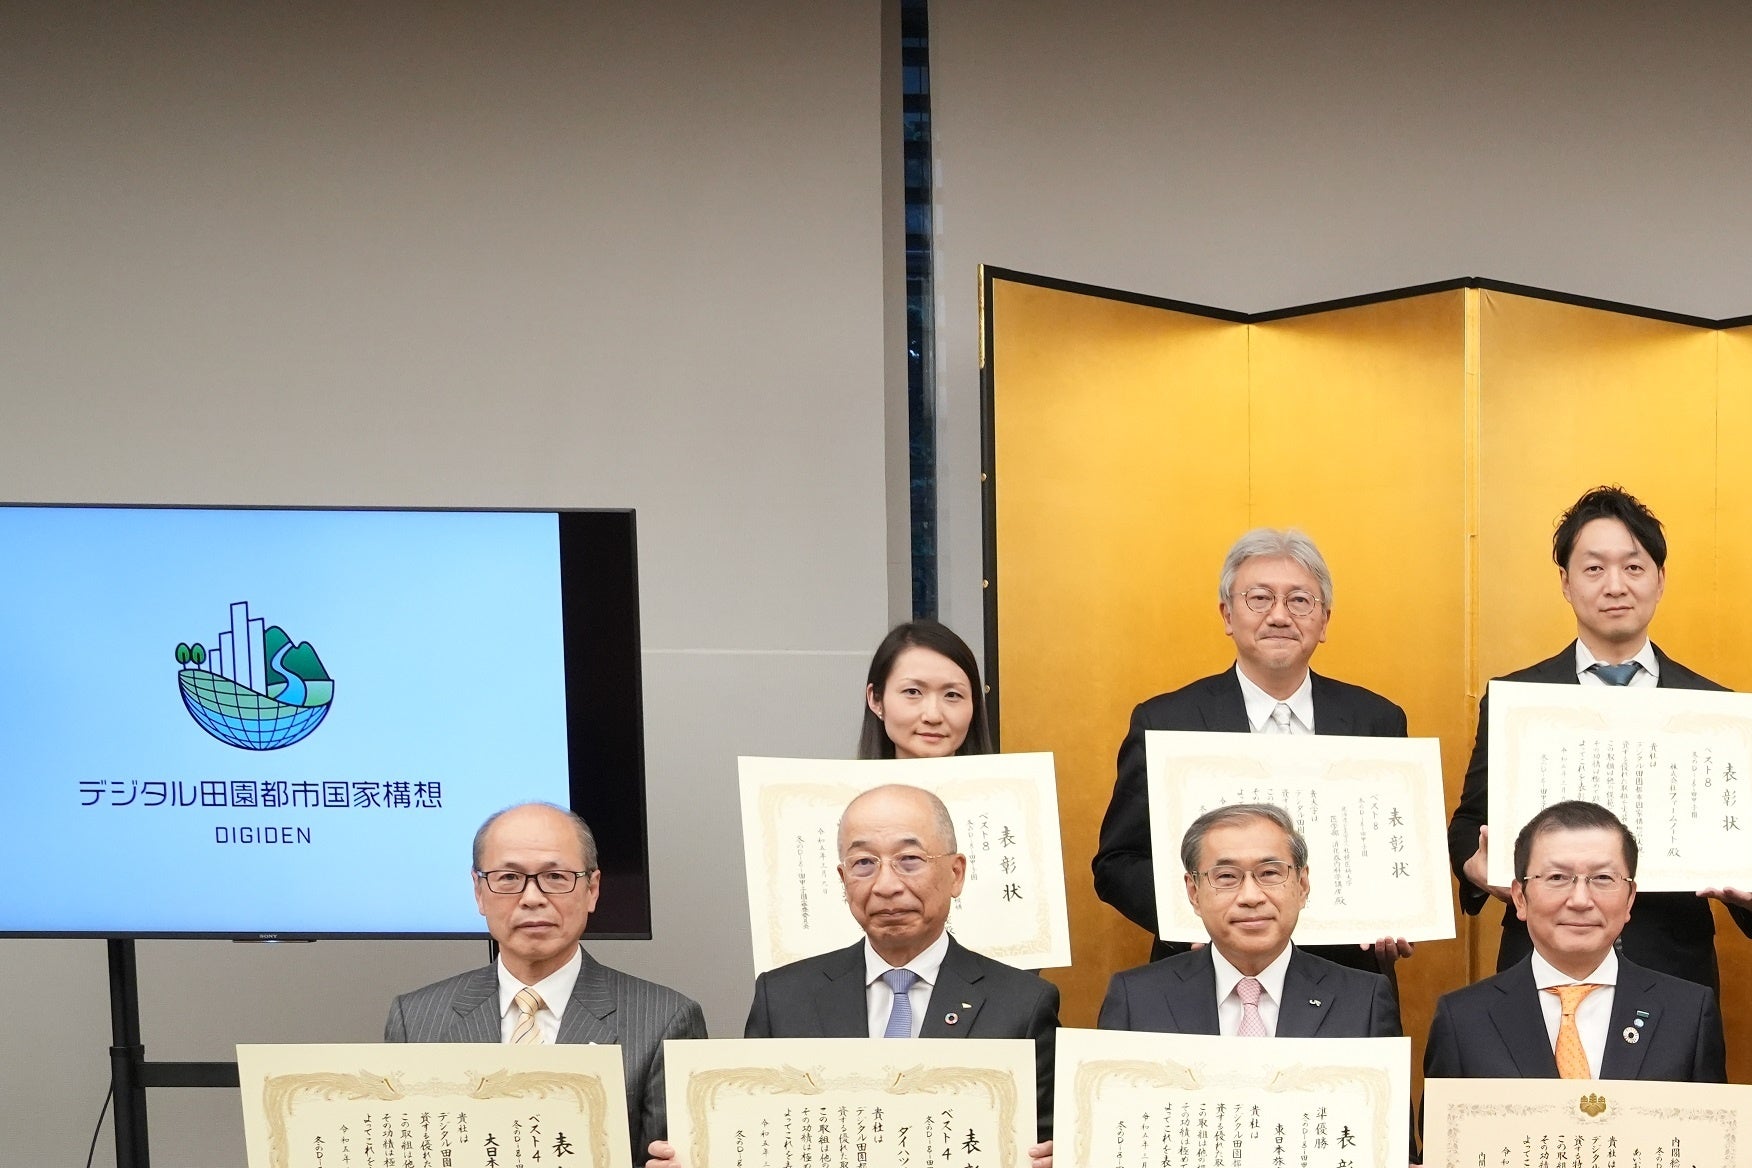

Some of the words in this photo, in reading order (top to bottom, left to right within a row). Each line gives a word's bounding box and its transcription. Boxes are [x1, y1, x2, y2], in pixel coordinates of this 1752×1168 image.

[1703, 746, 1712, 788] ベスト8
[79, 780, 442, 808] デジタル田園都市国家構想
[1722, 762, 1741, 832] 表彰状
[215, 826, 311, 844] DIGIDEN
[979, 812, 990, 852] ベスト8
[1388, 807, 1411, 879] 表彰状
[997, 825, 1023, 902] 表彰状
[456, 1111, 469, 1144] 貴社は
[528, 1113, 542, 1163] ベスト4
[871, 1106, 885, 1144] 貴社は
[940, 1108, 955, 1161] ベスト4
[1249, 1103, 1262, 1140] 貴社は
[1313, 1106, 1329, 1150] 準優勝
[1607, 1135, 1619, 1168] 貴社は
